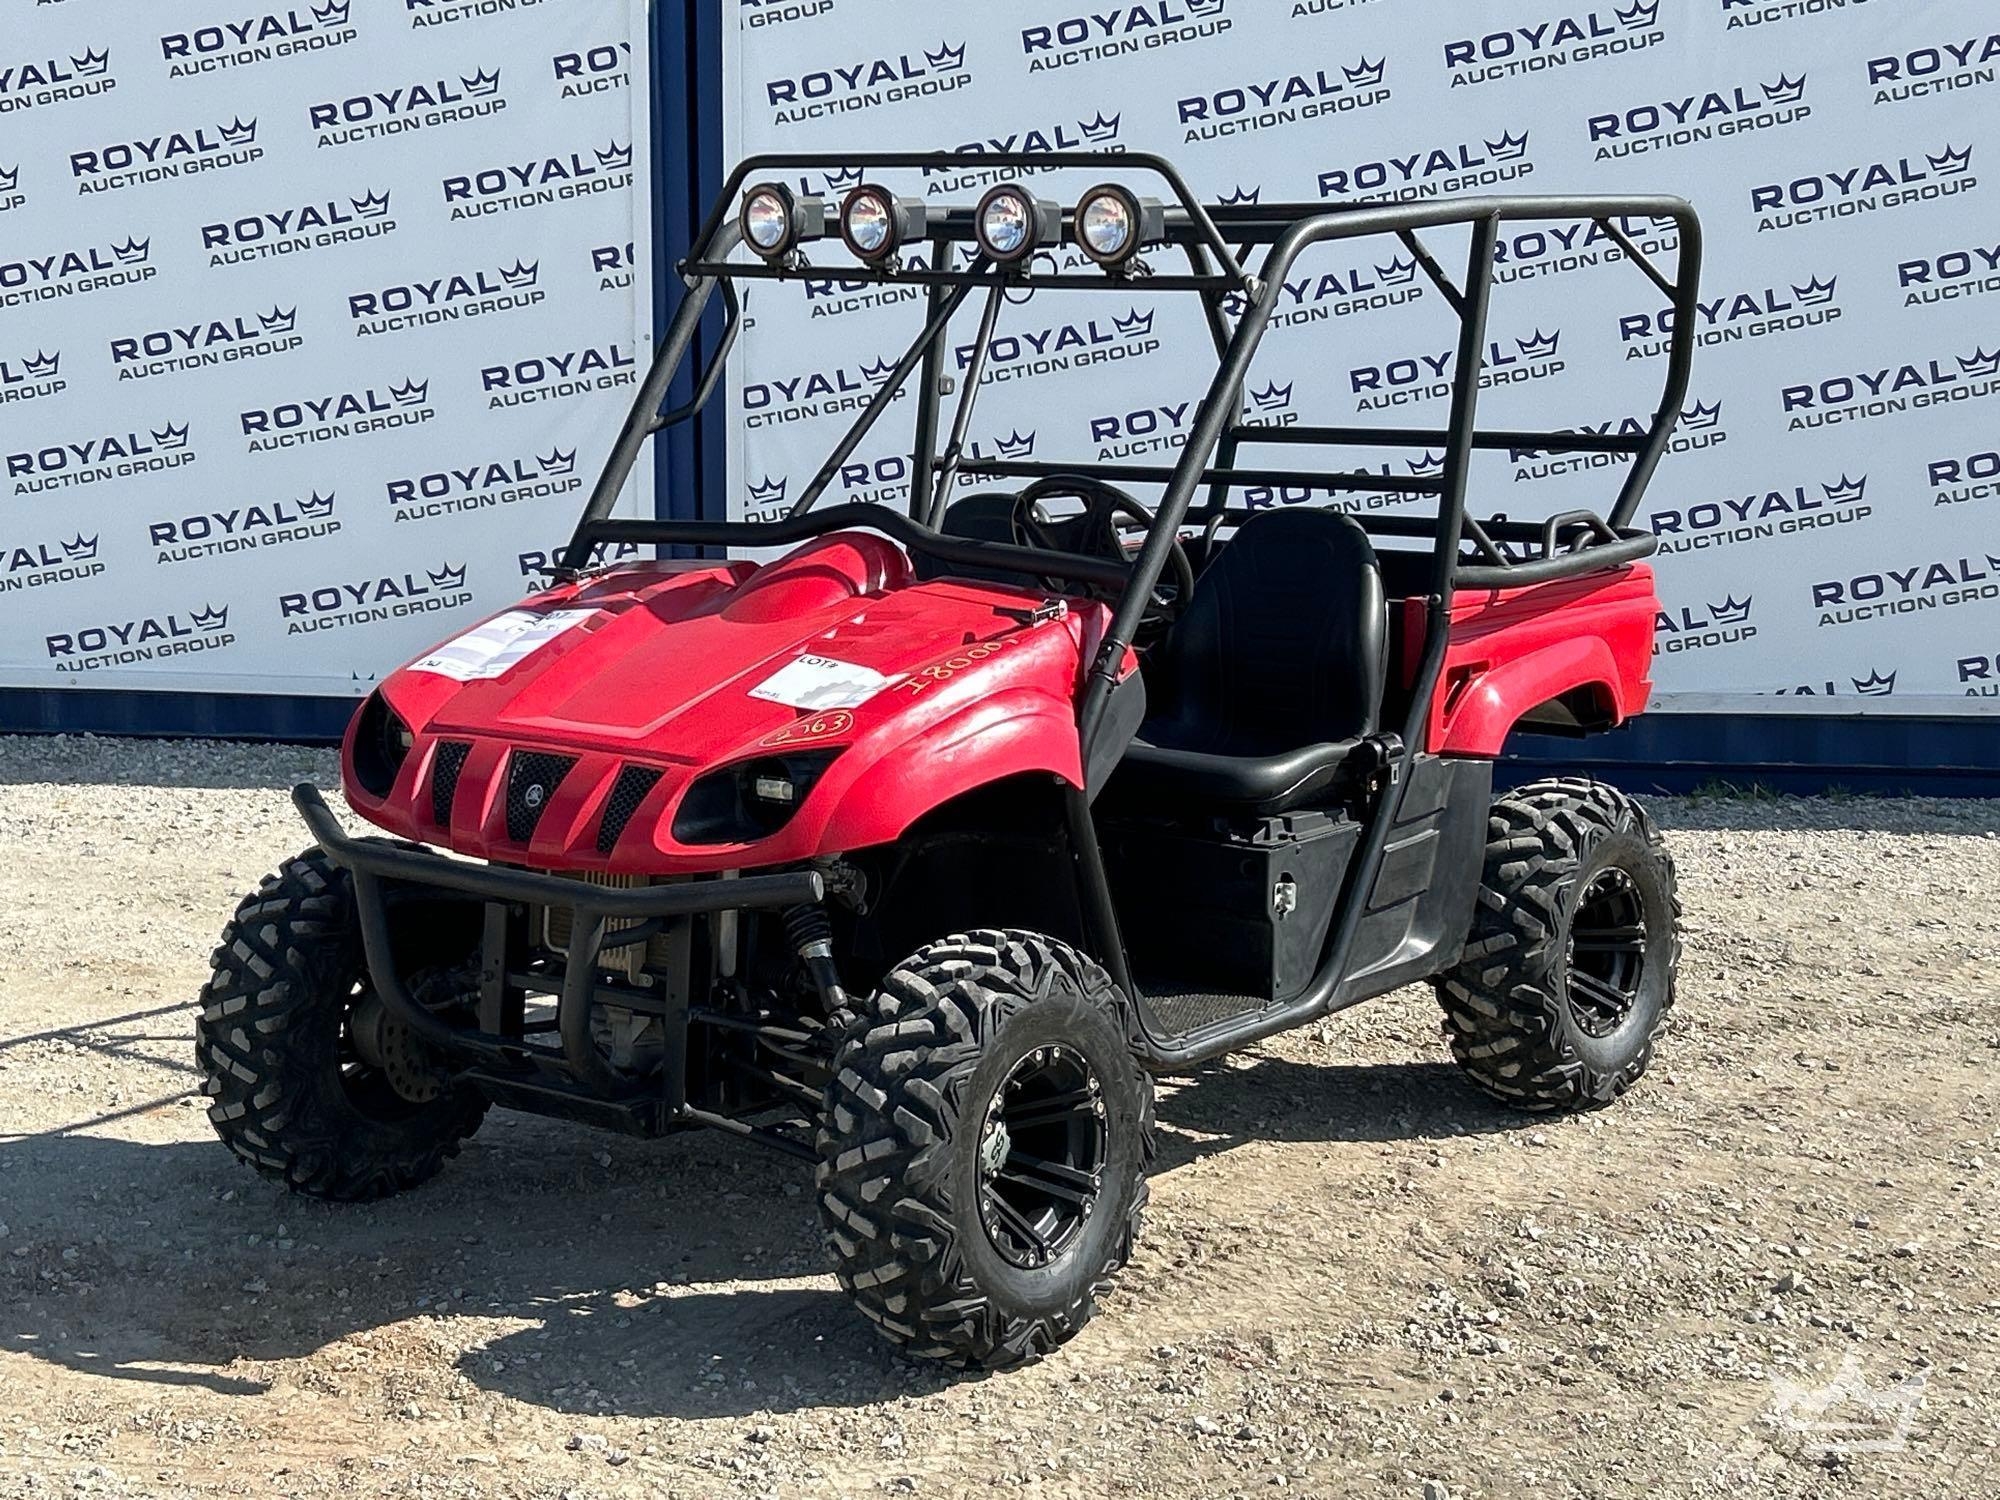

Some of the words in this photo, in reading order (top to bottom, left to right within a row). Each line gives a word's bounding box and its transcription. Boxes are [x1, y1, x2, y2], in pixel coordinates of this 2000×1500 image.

[160, 10, 314, 61] ROYAL
[748, 0, 834, 29] GROUP
[1021, 0, 1186, 55] ROYAL
[169, 46, 272, 79] AUCTION
[275, 28, 358, 57] GROUP
[1028, 37, 1140, 74] AUCTION
[1143, 18, 1233, 49] GROUP
[1443, 12, 1616, 69] ROYAL
[1450, 51, 1567, 89] AUCTION
[1571, 30, 1665, 63] GROUP
[1867, 34, 2000, 86] ROYA
[0, 60, 73, 94] YAL
[35, 78, 117, 106] GROUP
[561, 72, 630, 100] AUCTI
[766, 54, 927, 107] ROYAL
[774, 91, 882, 126] AUCTION
[886, 73, 972, 103] GROUP
[1176, 70, 1344, 125] ROYAL
[1873, 67, 1995, 106] AUCTION
[309, 80, 463, 130] ROYAL
[317, 115, 421, 149] AUCTION
[424, 98, 507, 127] GROUP
[1184, 108, 1297, 145] AUCTION
[1301, 88, 1391, 120] GROUP
[1587, 86, 1762, 142] ROYAL
[69, 128, 221, 178] ROYAL
[1594, 125, 1713, 163] AUCTION
[1717, 105, 1812, 137] GROUP
[78, 163, 180, 196] AUCTION
[182, 147, 264, 175] GROUP
[442, 153, 597, 203] ROYAL
[1317, 144, 1486, 199] ROYAL
[1442, 162, 1534, 193] GROUP
[1750, 157, 1927, 214] ROYAL
[200, 201, 354, 250] ROYAL
[450, 188, 555, 222] AUCTION
[1757, 196, 1877, 233] AUCTION
[1881, 176, 1977, 208] GROUP
[209, 236, 312, 268] AUCTION
[315, 220, 397, 248] GROUP
[1491, 251, 1599, 284] UCTION
[1603, 235, 1679, 263] GOU
[1897, 244, 2000, 288] ROY
[0, 247, 114, 288] OYAL
[0, 282, 74, 309] CTION
[77, 266, 157, 293] GROUP
[348, 271, 502, 319] ROYAL
[356, 306, 460, 338] AUCTION
[463, 290, 546, 317] GROUP
[810, 286, 918, 319] AUCTION
[1333, 287, 1424, 317] GROUP
[1903, 276, 2000, 308] AUCTIO
[110, 317, 261, 364] ROYAL
[1747, 307, 1842, 337] GROUP
[118, 351, 220, 382] AUCTION
[222, 335, 304, 362] GROUP
[480, 344, 636, 392] ROYAL
[979, 356, 1070, 386] UCTION
[1073, 339, 1161, 367] GROUP
[1349, 342, 1518, 394] ROYL
[0, 379, 67, 405] ROUP
[488, 378, 593, 410] AUCTION
[743, 369, 862, 410] OYAL
[743, 403, 819, 430] CTION
[822, 387, 907, 415] GROP
[1356, 381, 1451, 413] AUCTIO
[1781, 360, 1958, 413] ROYAL
[240, 389, 392, 436] ROYAL
[248, 423, 350, 454] AUCTION
[353, 408, 435, 434] GROUP
[1089, 401, 1200, 444] ROY
[1787, 397, 1907, 432] AUCTION
[5, 433, 154, 479] ROYAL
[1097, 433, 1188, 462] AUCTIO
[1664, 431, 1727, 455] OUP
[14, 466, 113, 496] AUCTION
[116, 451, 196, 477] GROUP
[385, 459, 539, 505] ROYAL
[850, 484, 909, 504] AUCT
[394, 492, 497, 523] AUCTION
[500, 477, 583, 504] GROUP
[1650, 486, 1824, 537] ROYAL
[148, 502, 299, 547] ROYAL
[157, 535, 258, 565] AUCTION
[260, 520, 342, 546] GROUP
[1656, 522, 1774, 557] AUCTION
[1778, 505, 1872, 534] GROUP
[26, 562, 106, 588] GROUP
[279, 573, 430, 618] ROYAL
[1811, 558, 1988, 609] ROYAL
[287, 606, 389, 636] AUCTION
[391, 592, 473, 618] GROUP
[1818, 594, 1937, 628] AUCTION
[1941, 584, 2000, 606] GRO
[45, 615, 193, 659] ROYAL
[156, 633, 236, 658] GROUP
[1665, 626, 1758, 654] GROUP
